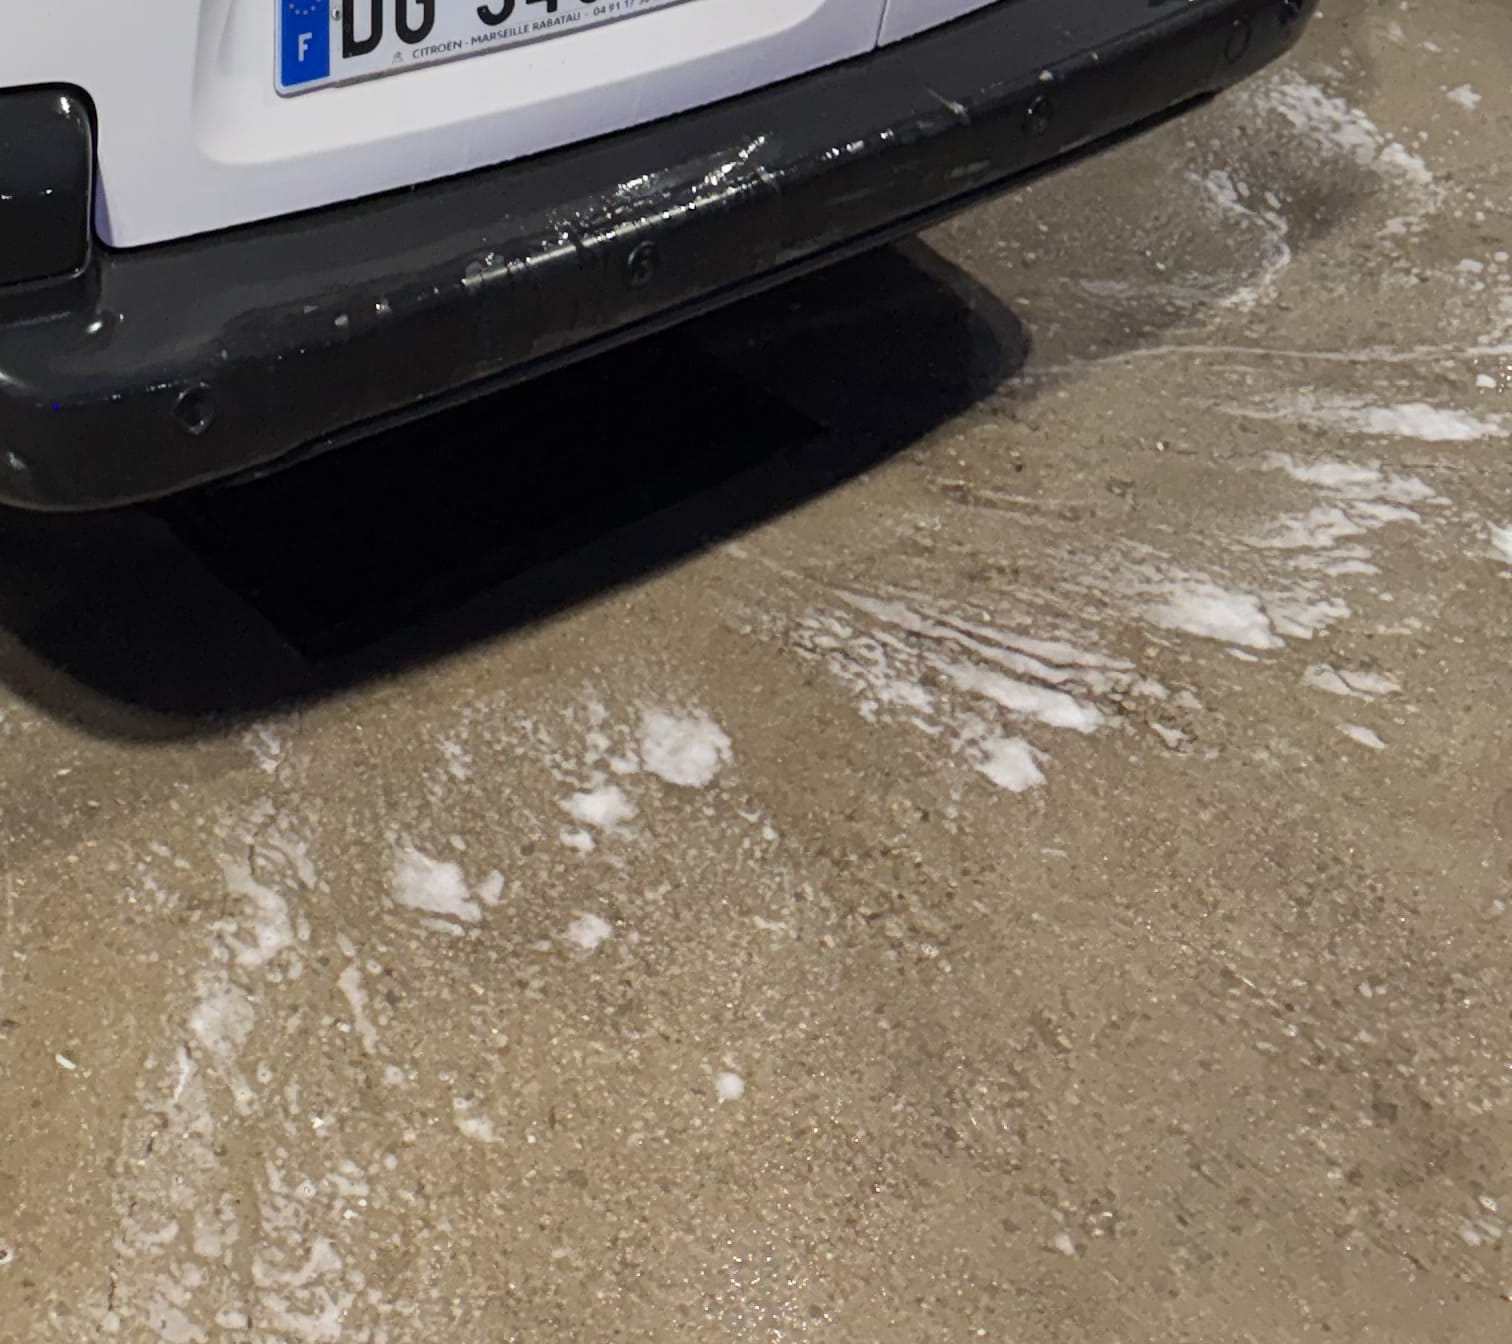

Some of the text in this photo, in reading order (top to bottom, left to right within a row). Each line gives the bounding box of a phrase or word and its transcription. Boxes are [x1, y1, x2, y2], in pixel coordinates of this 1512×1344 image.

[470, 24, 529, 45] MARSEILLE
[533, 12, 581, 33] RABATAU
[593, 6, 606, 16] 04
[298, 32, 312, 62] F
